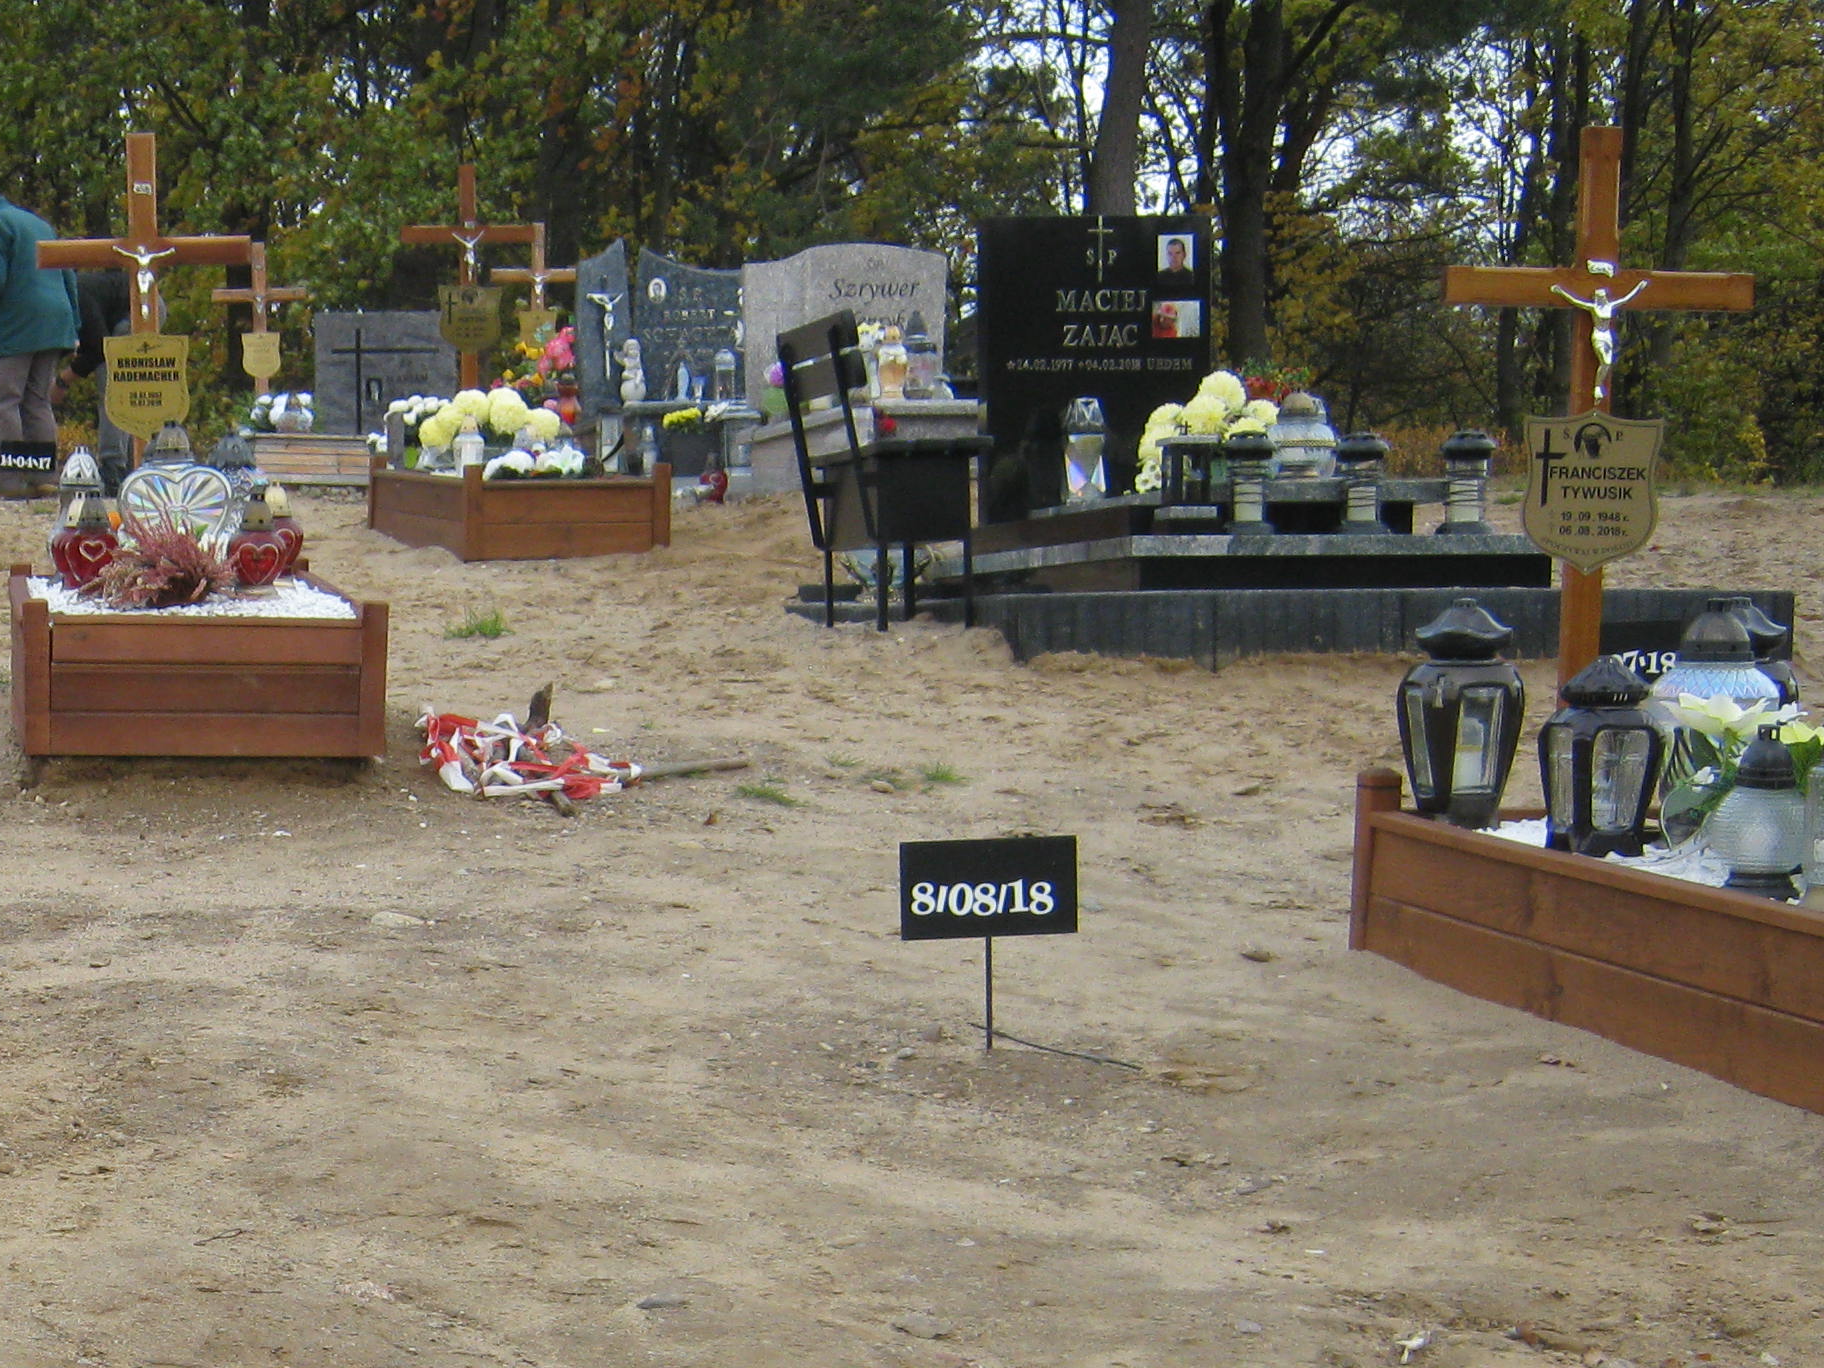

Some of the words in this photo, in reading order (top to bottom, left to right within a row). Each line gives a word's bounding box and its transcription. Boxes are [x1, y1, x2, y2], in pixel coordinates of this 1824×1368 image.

[828, 276, 921, 305] Szrywer
[1055, 289, 1149, 312] MACIEJ
[113, 371, 180, 382] RADEMACHER
[1549, 466, 1647, 481] FRANCISZEK
[1561, 486, 1633, 500] TYWUSIK
[911, 879, 1055, 916] 8/08/18
